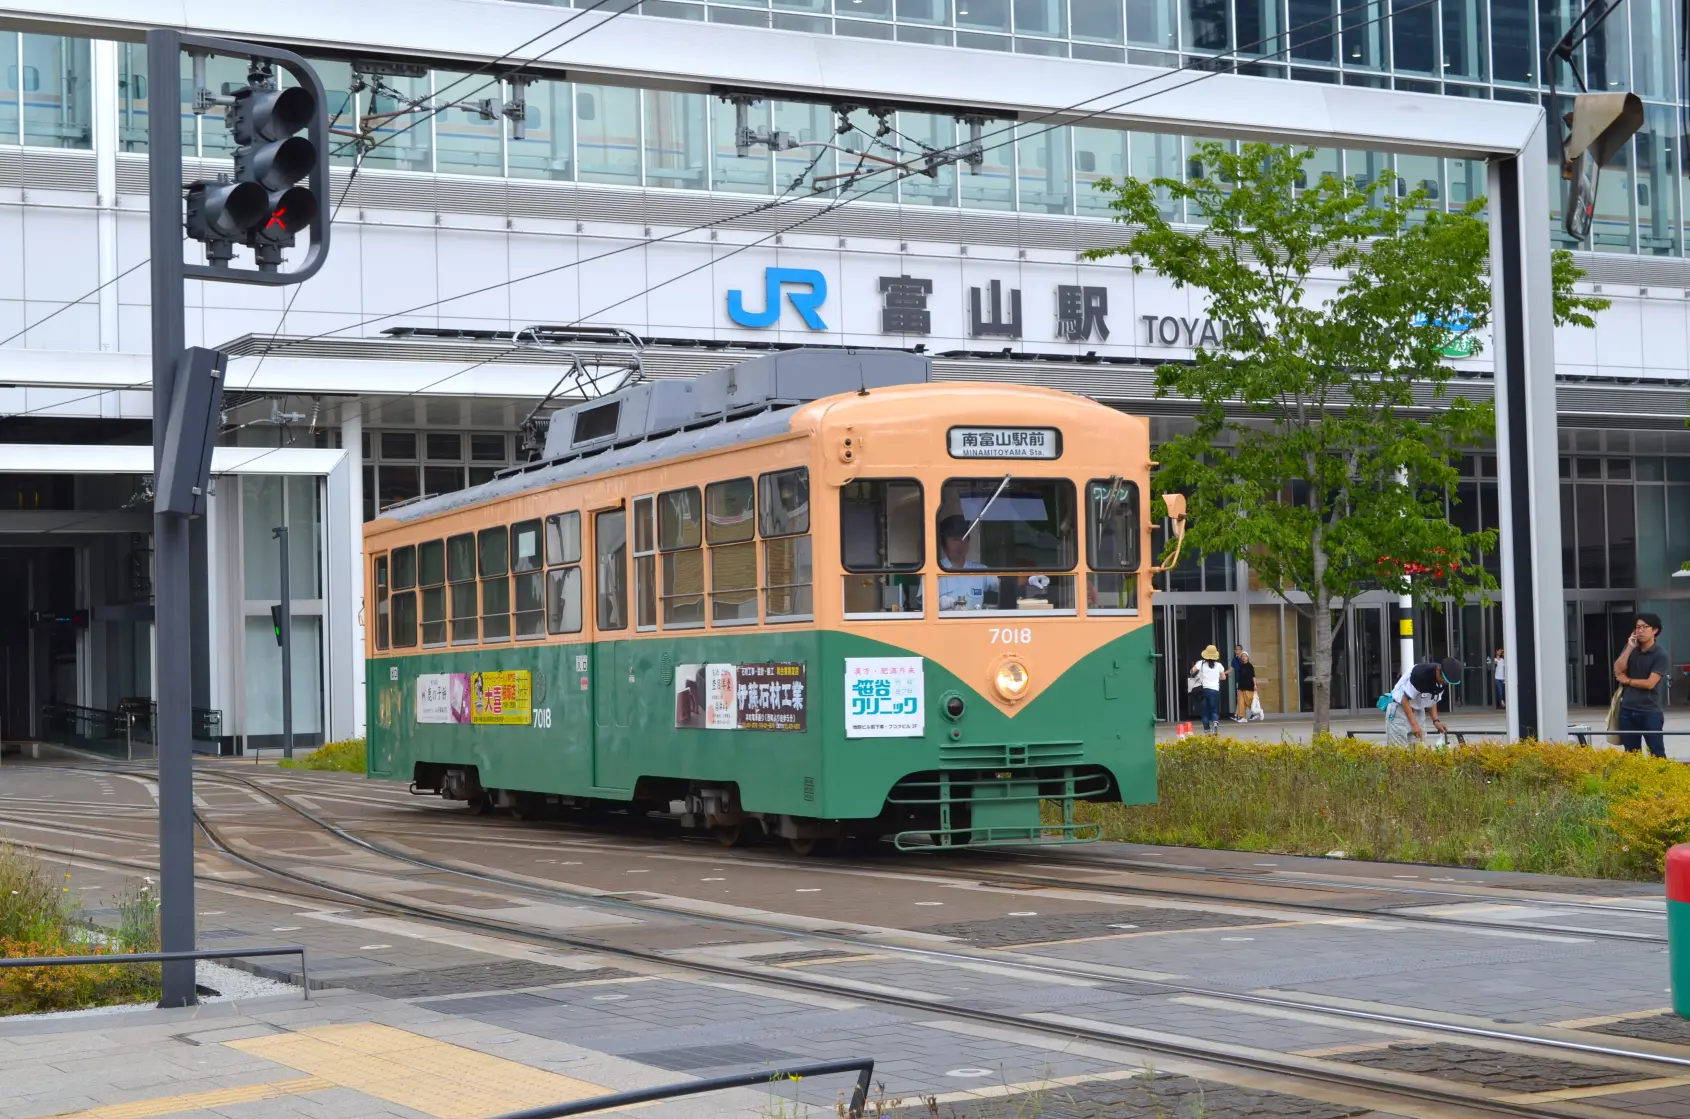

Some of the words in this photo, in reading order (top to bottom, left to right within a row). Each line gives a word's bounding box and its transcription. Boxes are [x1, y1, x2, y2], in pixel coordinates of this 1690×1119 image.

[727, 267, 828, 331] JR
[878, 274, 1110, 342] 富山駅
[962, 431, 1045, 447] 南富山駅前
[988, 628, 1032, 644] 7018
[484, 685, 502, 714] 大喜
[852, 697, 918, 715] クリニック
[532, 707, 552, 728] 7018
